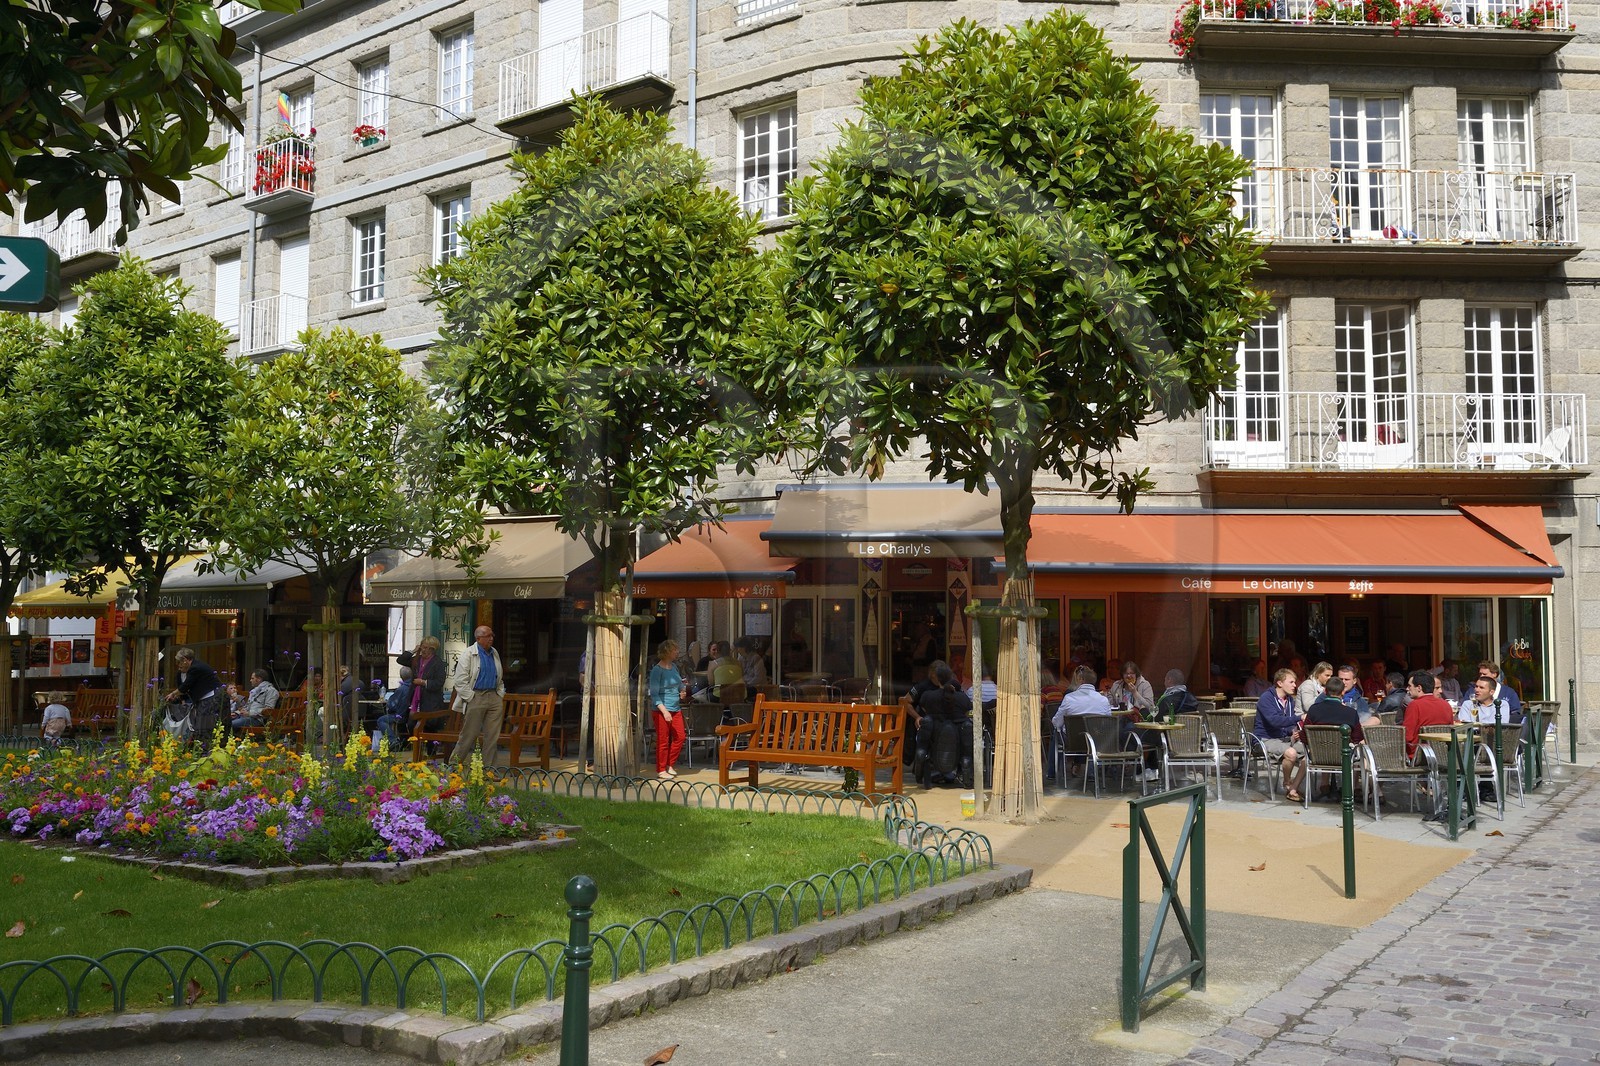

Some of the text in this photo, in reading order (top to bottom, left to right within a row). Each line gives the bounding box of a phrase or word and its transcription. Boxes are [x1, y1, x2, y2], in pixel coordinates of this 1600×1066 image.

[859, 542, 931, 557] Le Charly's
[1181, 577, 1211, 590] Café
[1243, 578, 1259, 590] Le
[1263, 578, 1314, 592] Charly's
[514, 585, 533, 599] Café
[190, 595, 198, 607] la
